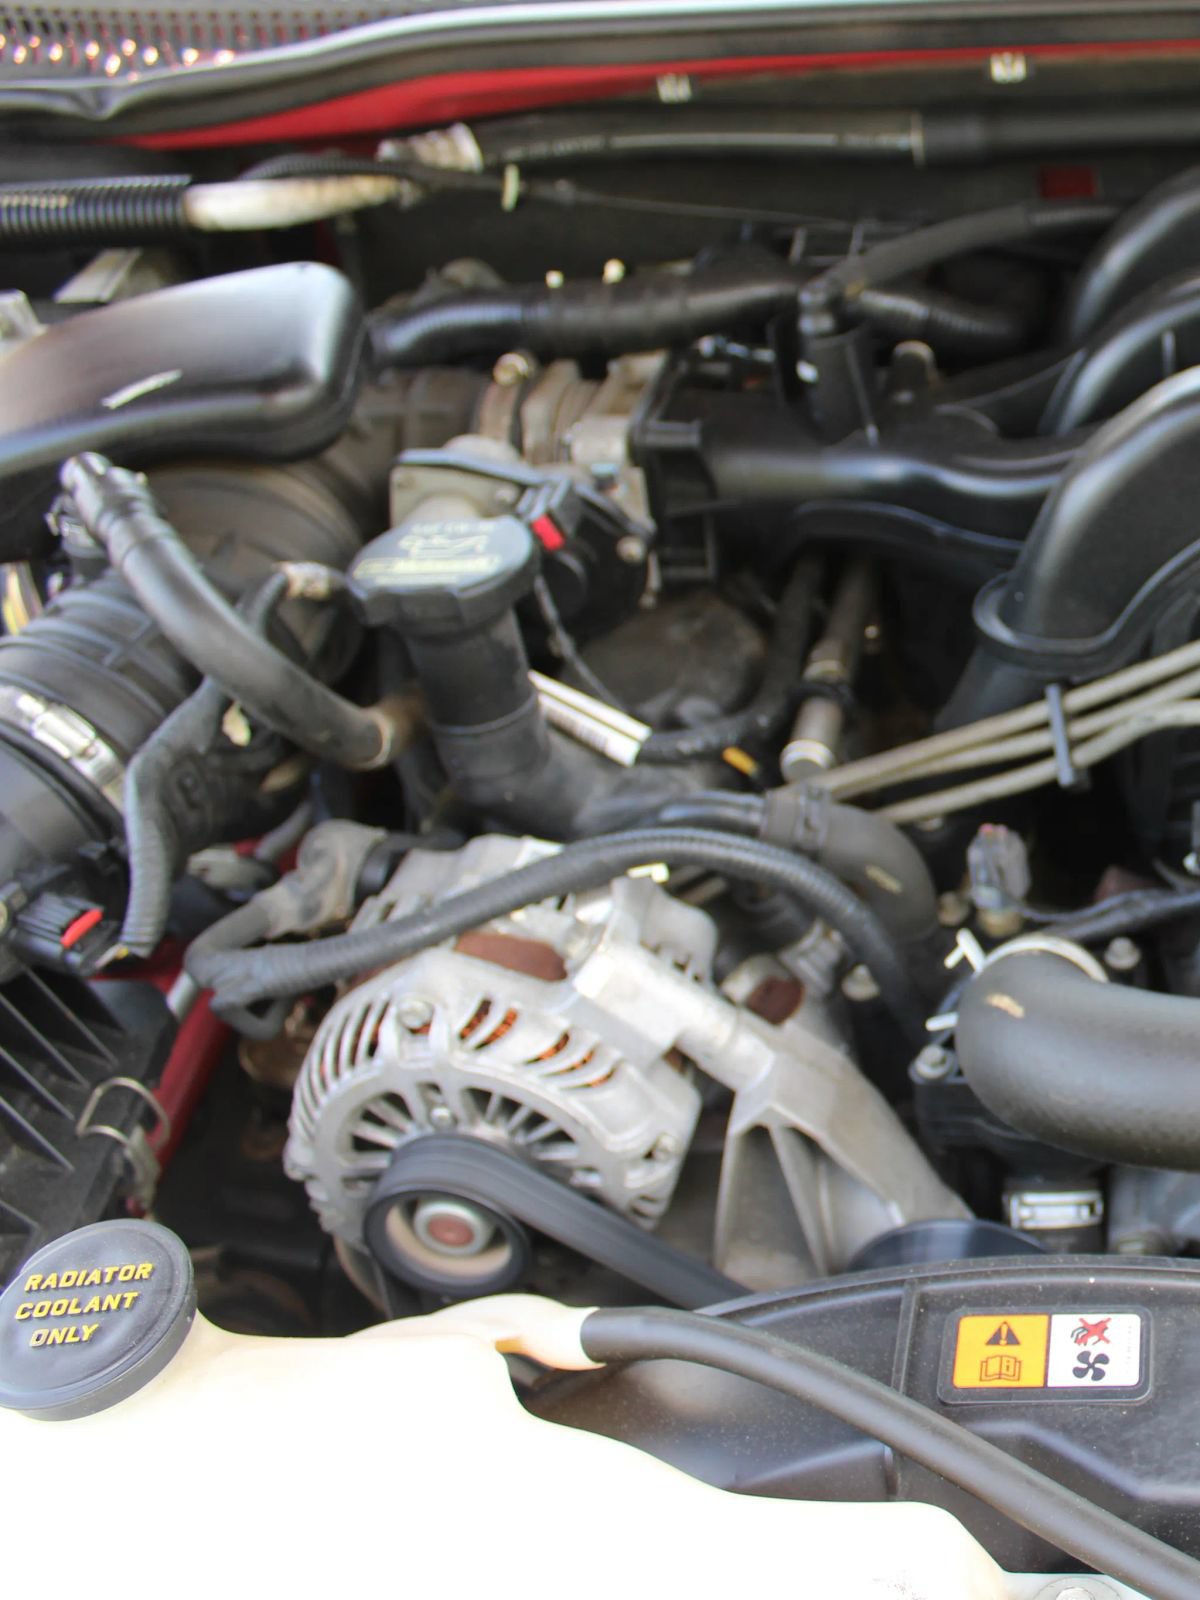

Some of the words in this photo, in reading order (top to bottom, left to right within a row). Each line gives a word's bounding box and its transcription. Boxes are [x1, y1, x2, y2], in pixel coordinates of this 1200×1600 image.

[24, 1263, 153, 1292] RADIATOR
[15, 1291, 138, 1320] COOLANT
[29, 1323, 99, 1347] ONLY
